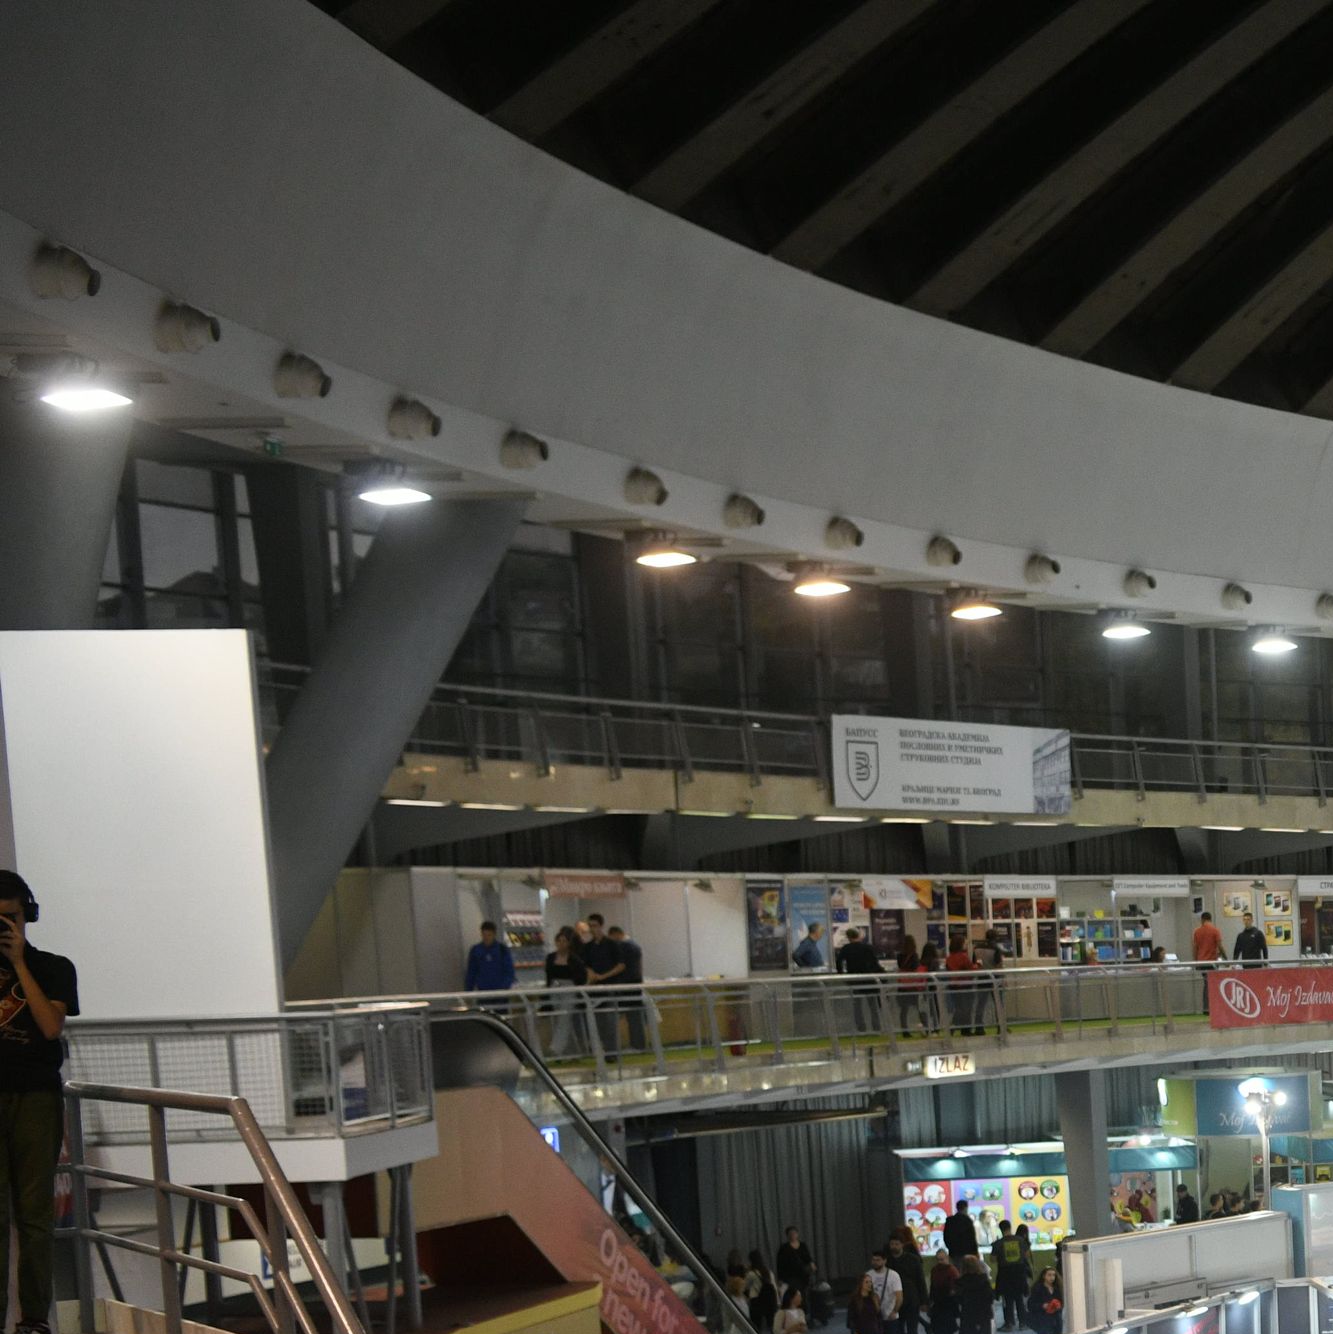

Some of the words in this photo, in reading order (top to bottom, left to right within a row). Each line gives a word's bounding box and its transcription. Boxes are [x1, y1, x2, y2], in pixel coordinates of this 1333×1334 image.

[1229, 979, 1251, 1016] JRJ
[1266, 987, 1291, 1017] Moj
[934, 1056, 970, 1074] IZLAZ
[600, 1228, 650, 1313] Open
